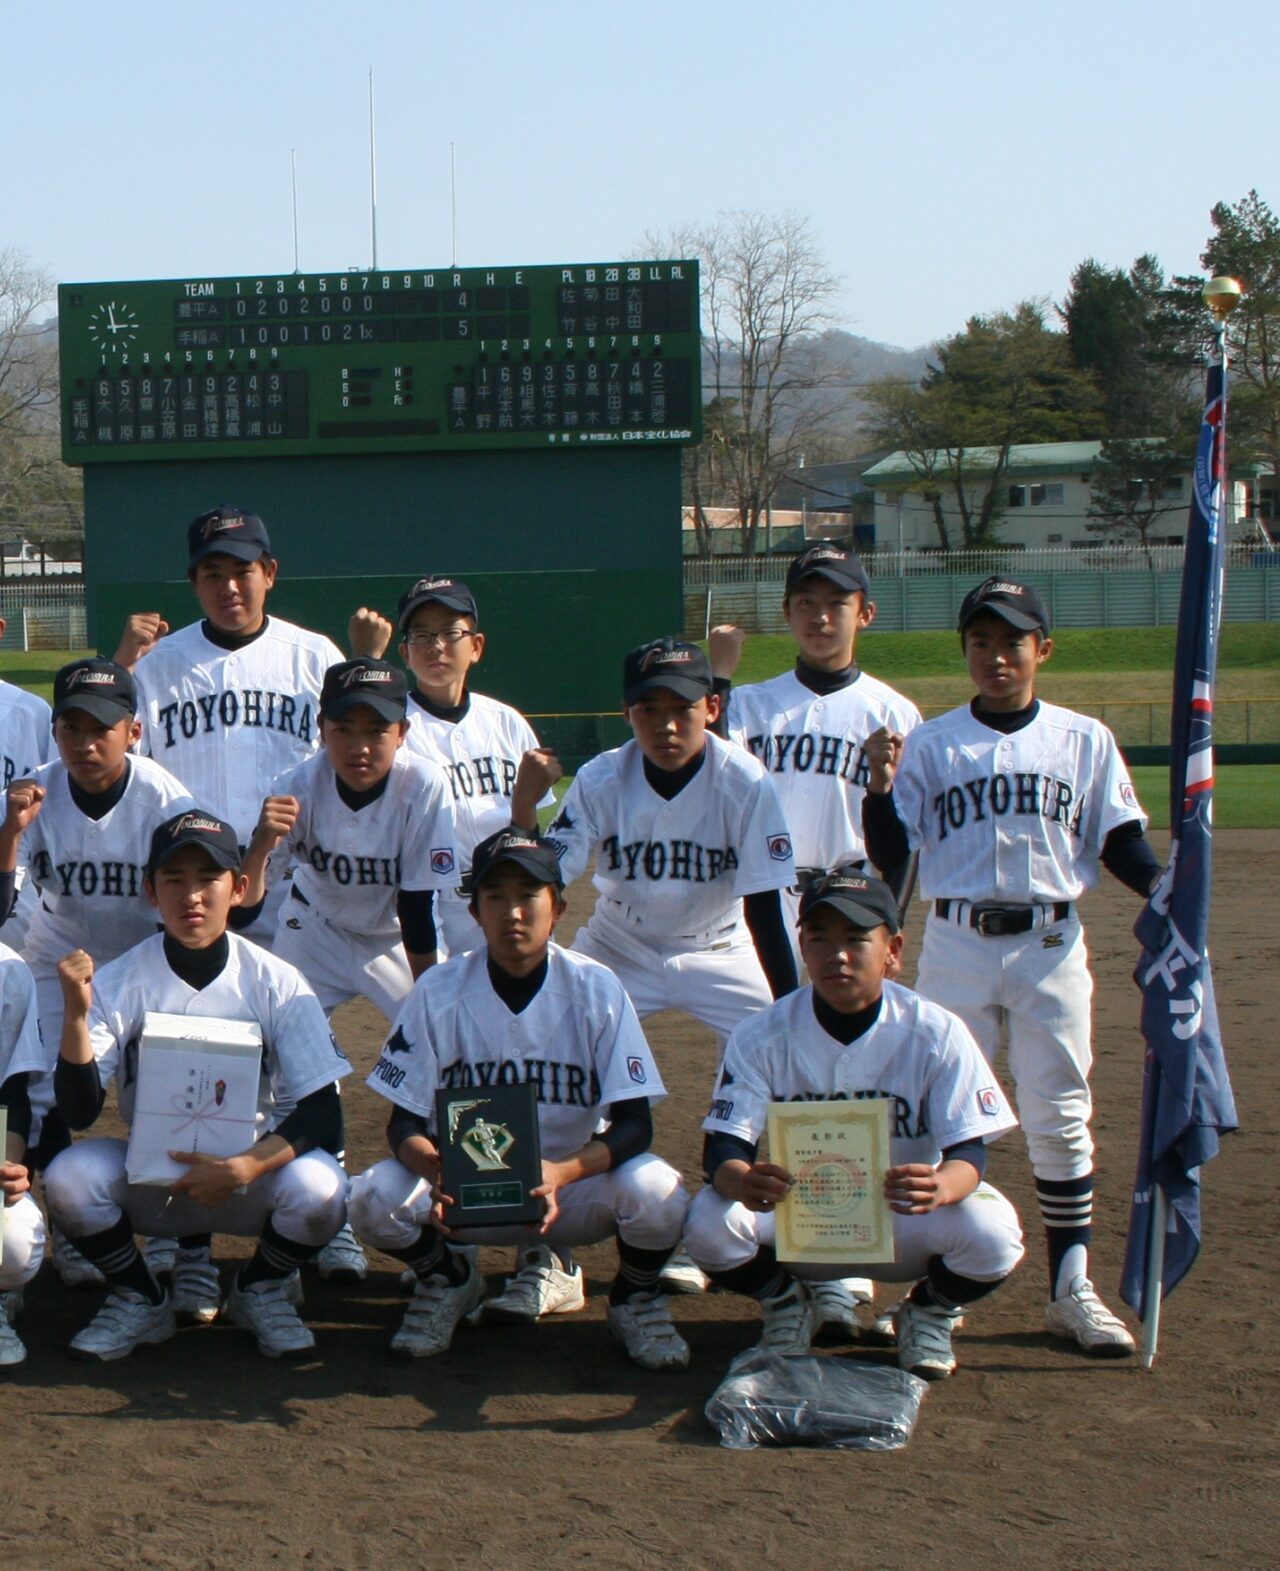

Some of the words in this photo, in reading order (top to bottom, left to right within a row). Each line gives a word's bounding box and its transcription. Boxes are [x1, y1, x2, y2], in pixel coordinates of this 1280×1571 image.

[184, 283, 214, 298] TEAM
[235, 282, 242, 295] 1
[255, 281, 263, 295] 2
[276, 280, 284, 294] 3
[297, 279, 306, 293] 4
[319, 278, 327, 292] 5
[340, 277, 348, 291] 6
[361, 276, 369, 290] 7
[382, 275, 390, 289] 8
[403, 274, 412, 288] 9
[423, 274, 434, 288] 10
[453, 275, 461, 287] R
[486, 273, 494, 285] H
[515, 272, 522, 284] E
[561, 271, 574, 283] PL
[585, 270, 596, 282] 1B
[605, 269, 618, 282] 2B
[627, 268, 640, 281] 3B
[650, 267, 661, 280] LL
[671, 266, 683, 279] RL
[237, 302, 246, 317] 0
[258, 301, 267, 315] 2
[279, 300, 288, 314] 0
[300, 299, 309, 313] 2
[322, 298, 330, 313] 0
[343, 297, 352, 312] 0
[364, 296, 372, 311] 0
[458, 292, 467, 308] 4
[606, 288, 619, 330] 田中
[627, 287, 641, 329] 大和田
[239, 328, 245, 344] 1
[259, 327, 268, 342] 0
[280, 326, 289, 342] 0
[303, 325, 308, 341] 1
[322, 325, 330, 340] 0
[343, 324, 352, 340] 2
[458, 319, 467, 336] 5
[481, 340, 486, 350] 1
[501, 340, 508, 350] 2
[523, 339, 530, 350] 3
[544, 338, 552, 349] 4
[566, 338, 573, 348] 5
[588, 337, 595, 348] 6
[609, 336, 617, 347] 7
[632, 335, 639, 346] 8
[654, 334, 661, 345] 9
[101, 354, 106, 365] 1
[122, 353, 128, 364] 2
[143, 353, 149, 363] 3
[164, 352, 171, 363] 4
[185, 351, 192, 362] 5
[207, 350, 213, 361] 6
[228, 350, 235, 360] 7
[249, 349, 256, 359] 8
[271, 347, 278, 358] 9
[394, 367, 402, 377] H
[482, 368, 487, 384] 1
[501, 367, 510, 383] 6
[522, 366, 531, 382] 9
[544, 365, 553, 381] 3
[565, 364, 575, 380] 5
[588, 363, 597, 379] 8
[609, 362, 618, 378] 7
[631, 362, 641, 377] 4
[653, 361, 662, 377] 2
[100, 381, 109, 397] 6
[120, 380, 130, 396] 5
[142, 379, 151, 395] 8
[163, 379, 172, 394] 7
[187, 378, 192, 393] 1
[206, 377, 215, 393] 9
[227, 376, 236, 392] 2
[248, 375, 257, 391] 4
[270, 375, 279, 390] 3
[395, 380, 402, 391] E
[182, 395, 198, 438] 金田
[267, 391, 282, 435] 中山
[476, 386, 492, 429] 平野
[542, 383, 557, 425] 佐々木
[159, 690, 317, 749] TOYOHIRA
[933, 774, 1085, 841] TOYOHIRA
